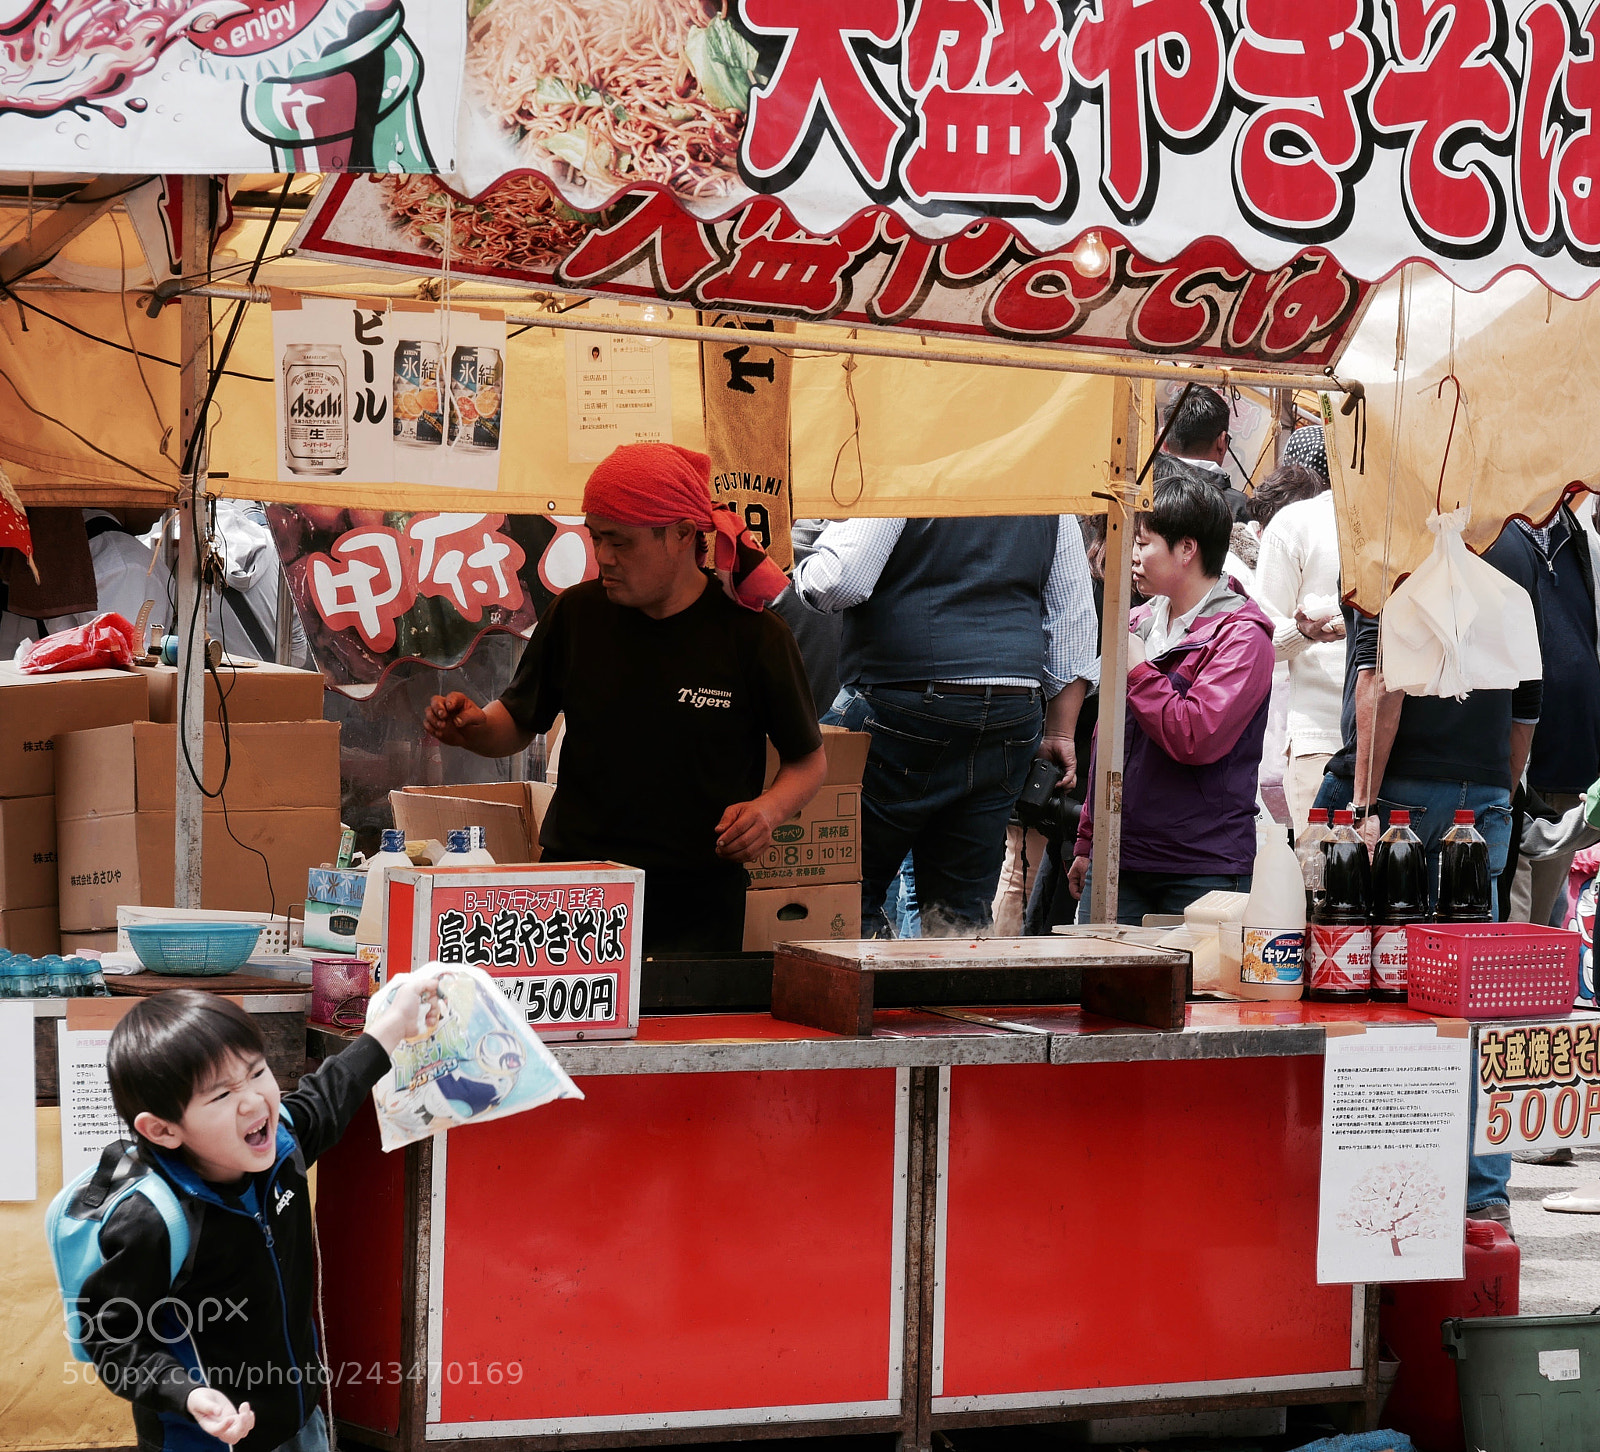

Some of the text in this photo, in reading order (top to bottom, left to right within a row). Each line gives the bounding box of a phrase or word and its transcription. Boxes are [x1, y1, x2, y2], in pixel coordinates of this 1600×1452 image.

[230, 0, 297, 48] enjoy
[353, 309, 387, 424] ビール
[402, 357, 438, 380] 氷結
[459, 362, 496, 386] 氷結
[290, 392, 342, 418] Asahi
[309, 429, 325, 440] 生
[714, 472, 783, 497] FUJINAMI
[678, 688, 732, 708] Tigers
[698, 687, 732, 698] HANSHIN
[773, 828, 804, 840] キャベツ
[33, 852, 58, 864] 株式
[769, 846, 853, 865] 6 8 9 10 12
[568, 886, 605, 910] 王者
[438, 904, 628, 967] 富士宮やきそば
[1264, 947, 1304, 963] キャノーラ
[526, 976, 616, 1023] 500円
[1481, 1026, 1600, 1084] 大盛焼きそ
